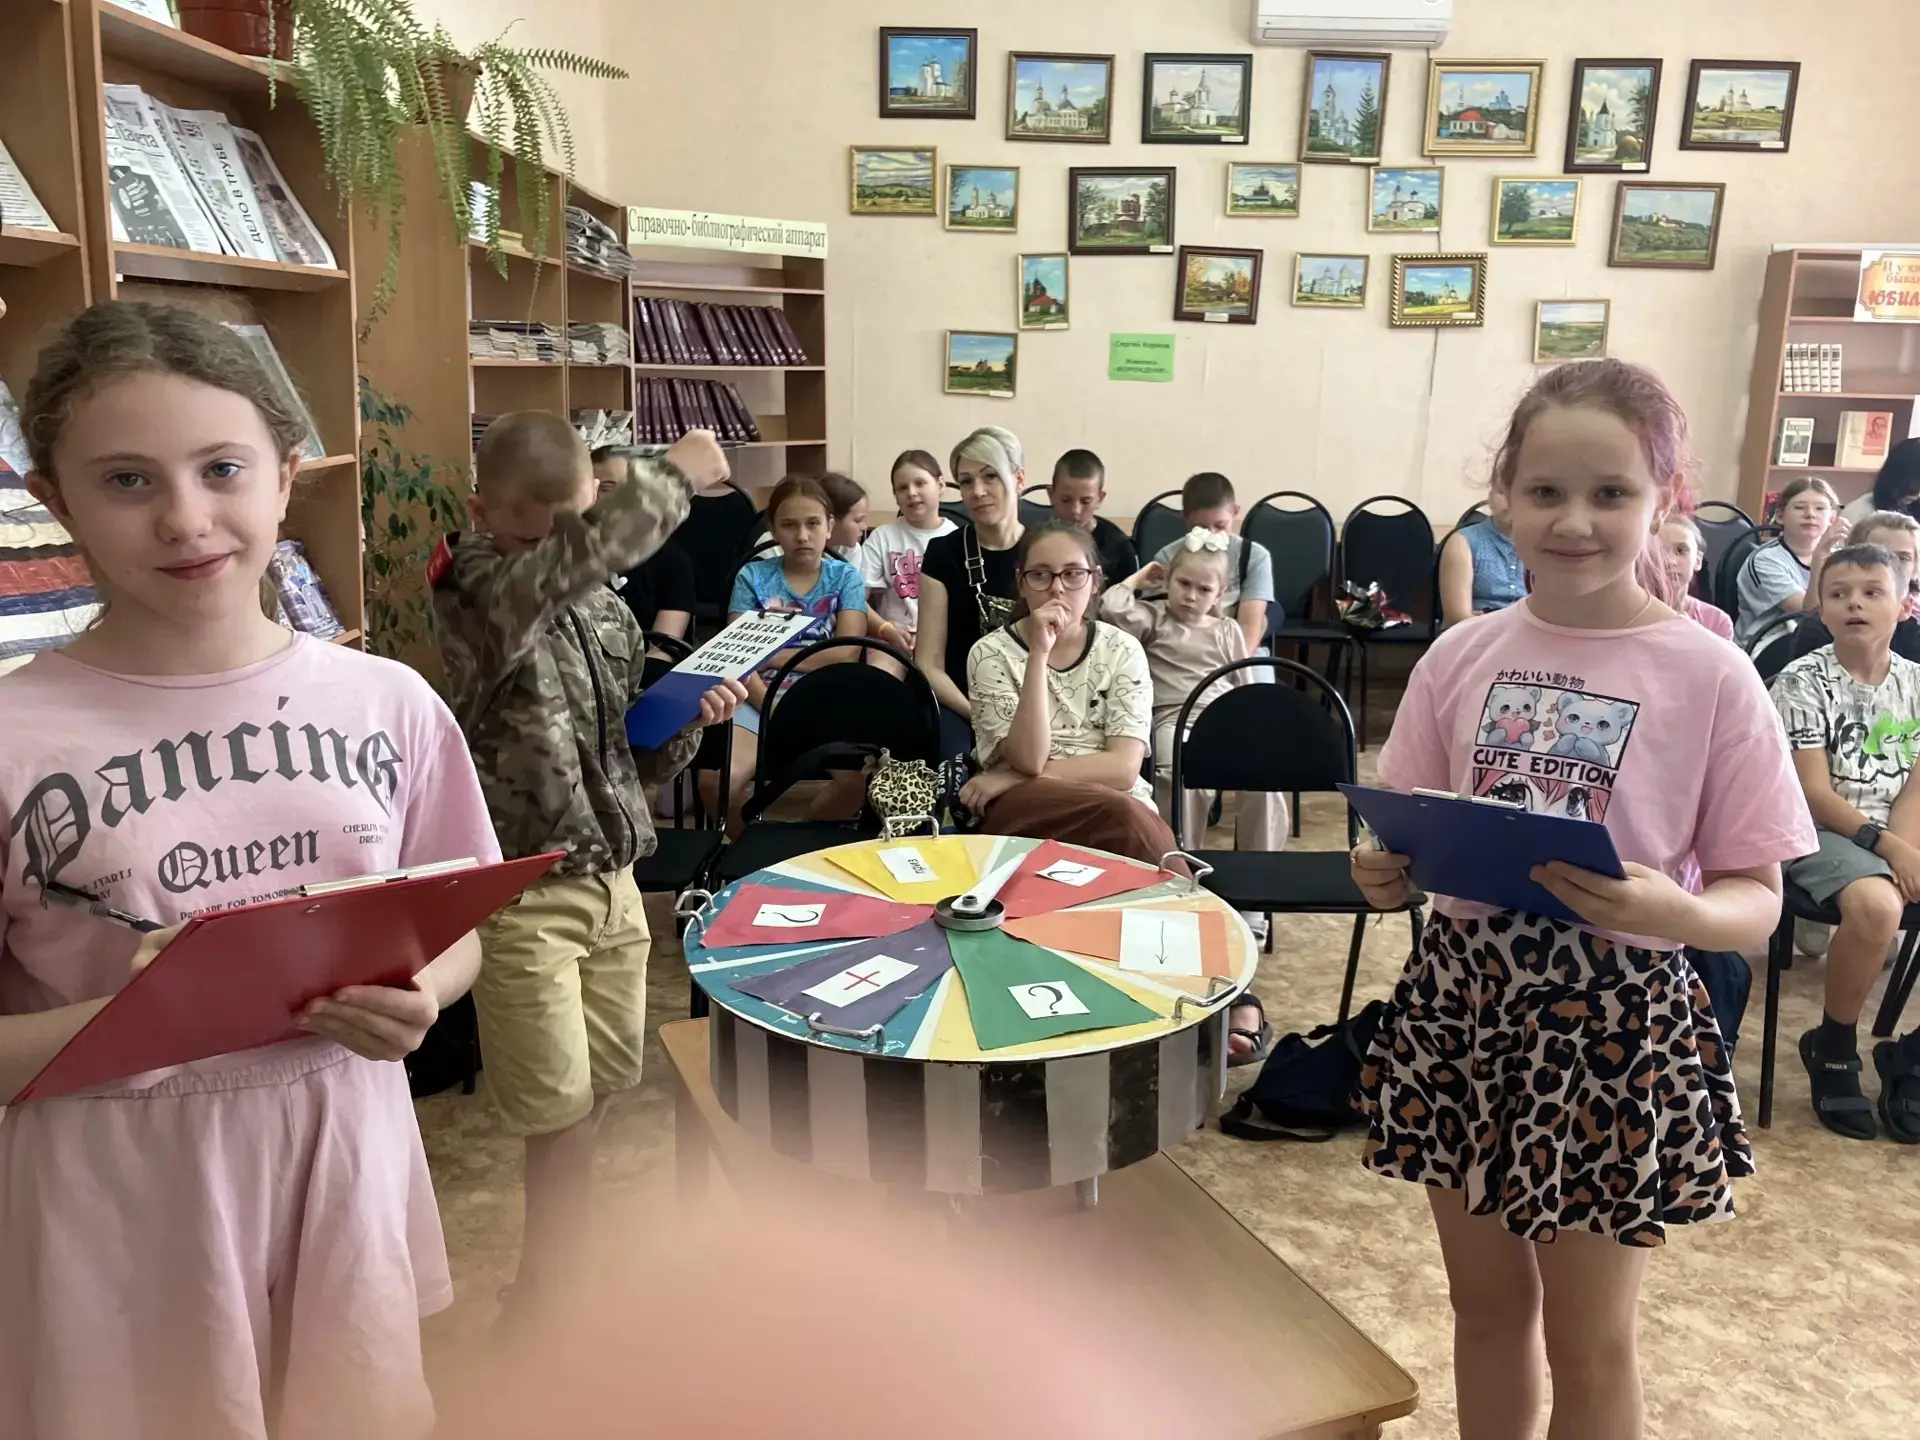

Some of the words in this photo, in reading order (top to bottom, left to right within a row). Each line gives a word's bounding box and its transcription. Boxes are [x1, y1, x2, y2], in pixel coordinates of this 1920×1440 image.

[212, 142, 237, 184] ТРУБЕ
[232, 189, 243, 198] В
[239, 202, 264, 244] ДЕЛО
[785, 228, 826, 252] аппарат
[1883, 261, 1893, 273] И
[1494, 669, 1586, 690] かわいい動物
[1473, 748, 1521, 770] CUTE
[1529, 755, 1618, 789] EDITION
[158, 829, 320, 894] Queen
[227, 899, 247, 910] FOR
